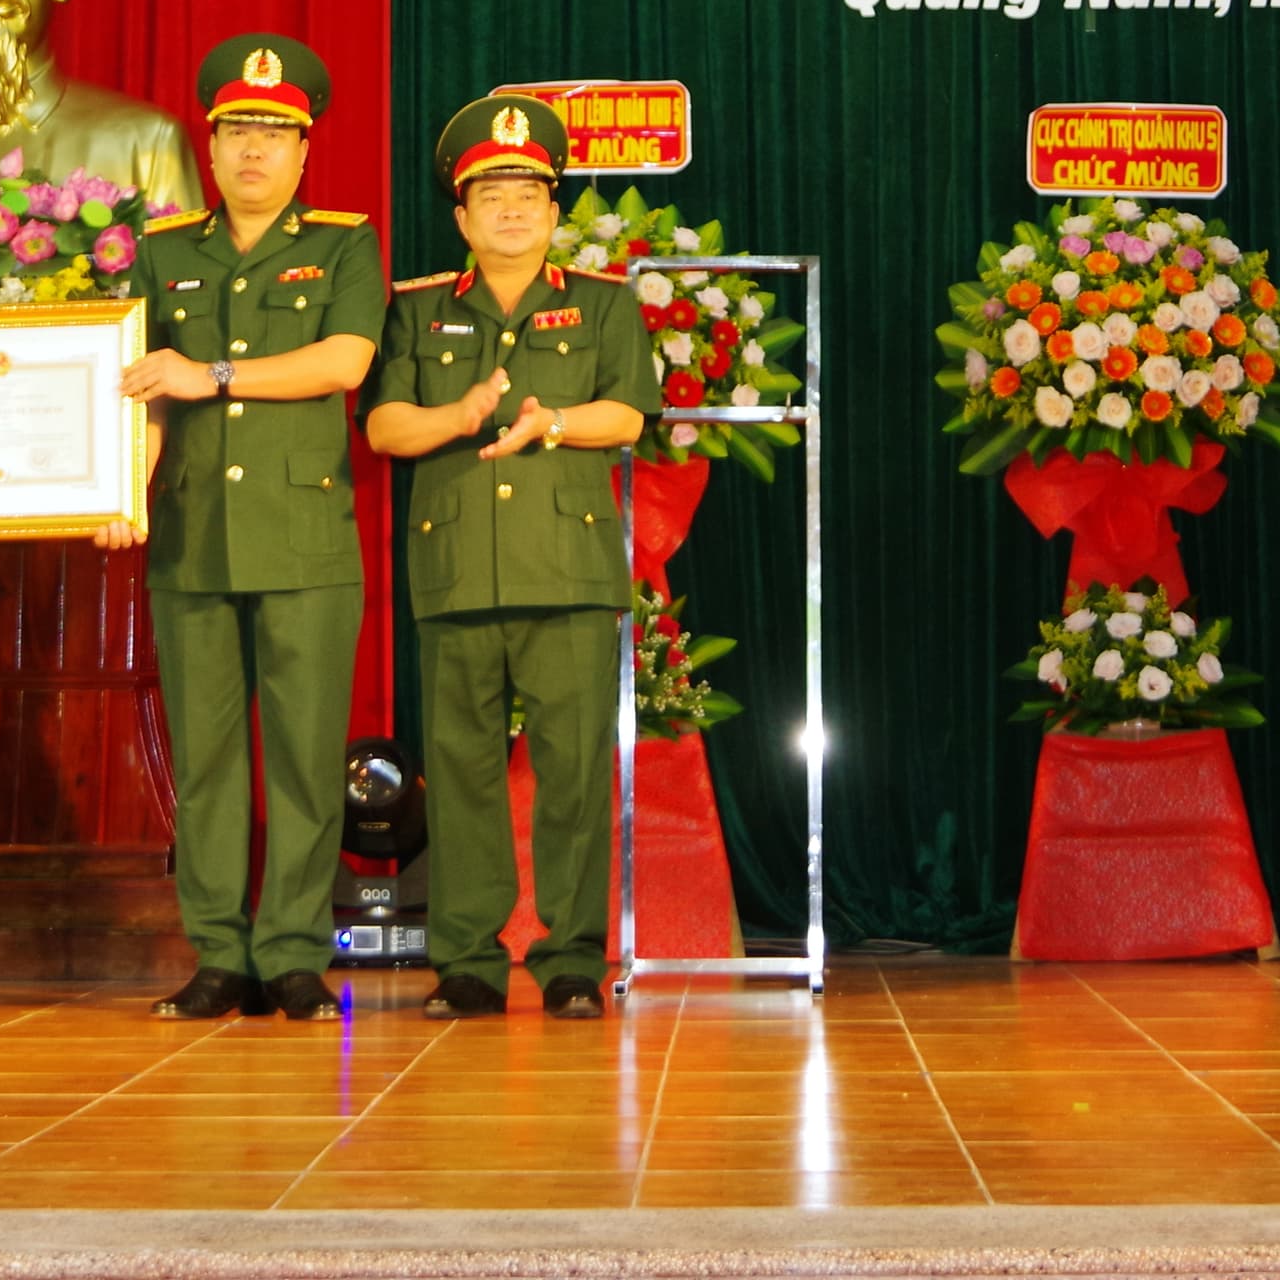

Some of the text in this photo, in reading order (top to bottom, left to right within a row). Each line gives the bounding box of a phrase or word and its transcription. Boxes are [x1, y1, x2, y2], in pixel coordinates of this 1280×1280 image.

[588, 131, 661, 162] MỪNG
[1037, 112, 1218, 155] CỤC CHÍNH TRỊ QUÂN KHU 5
[1053, 154, 1199, 187] CHÚC MỪNG
